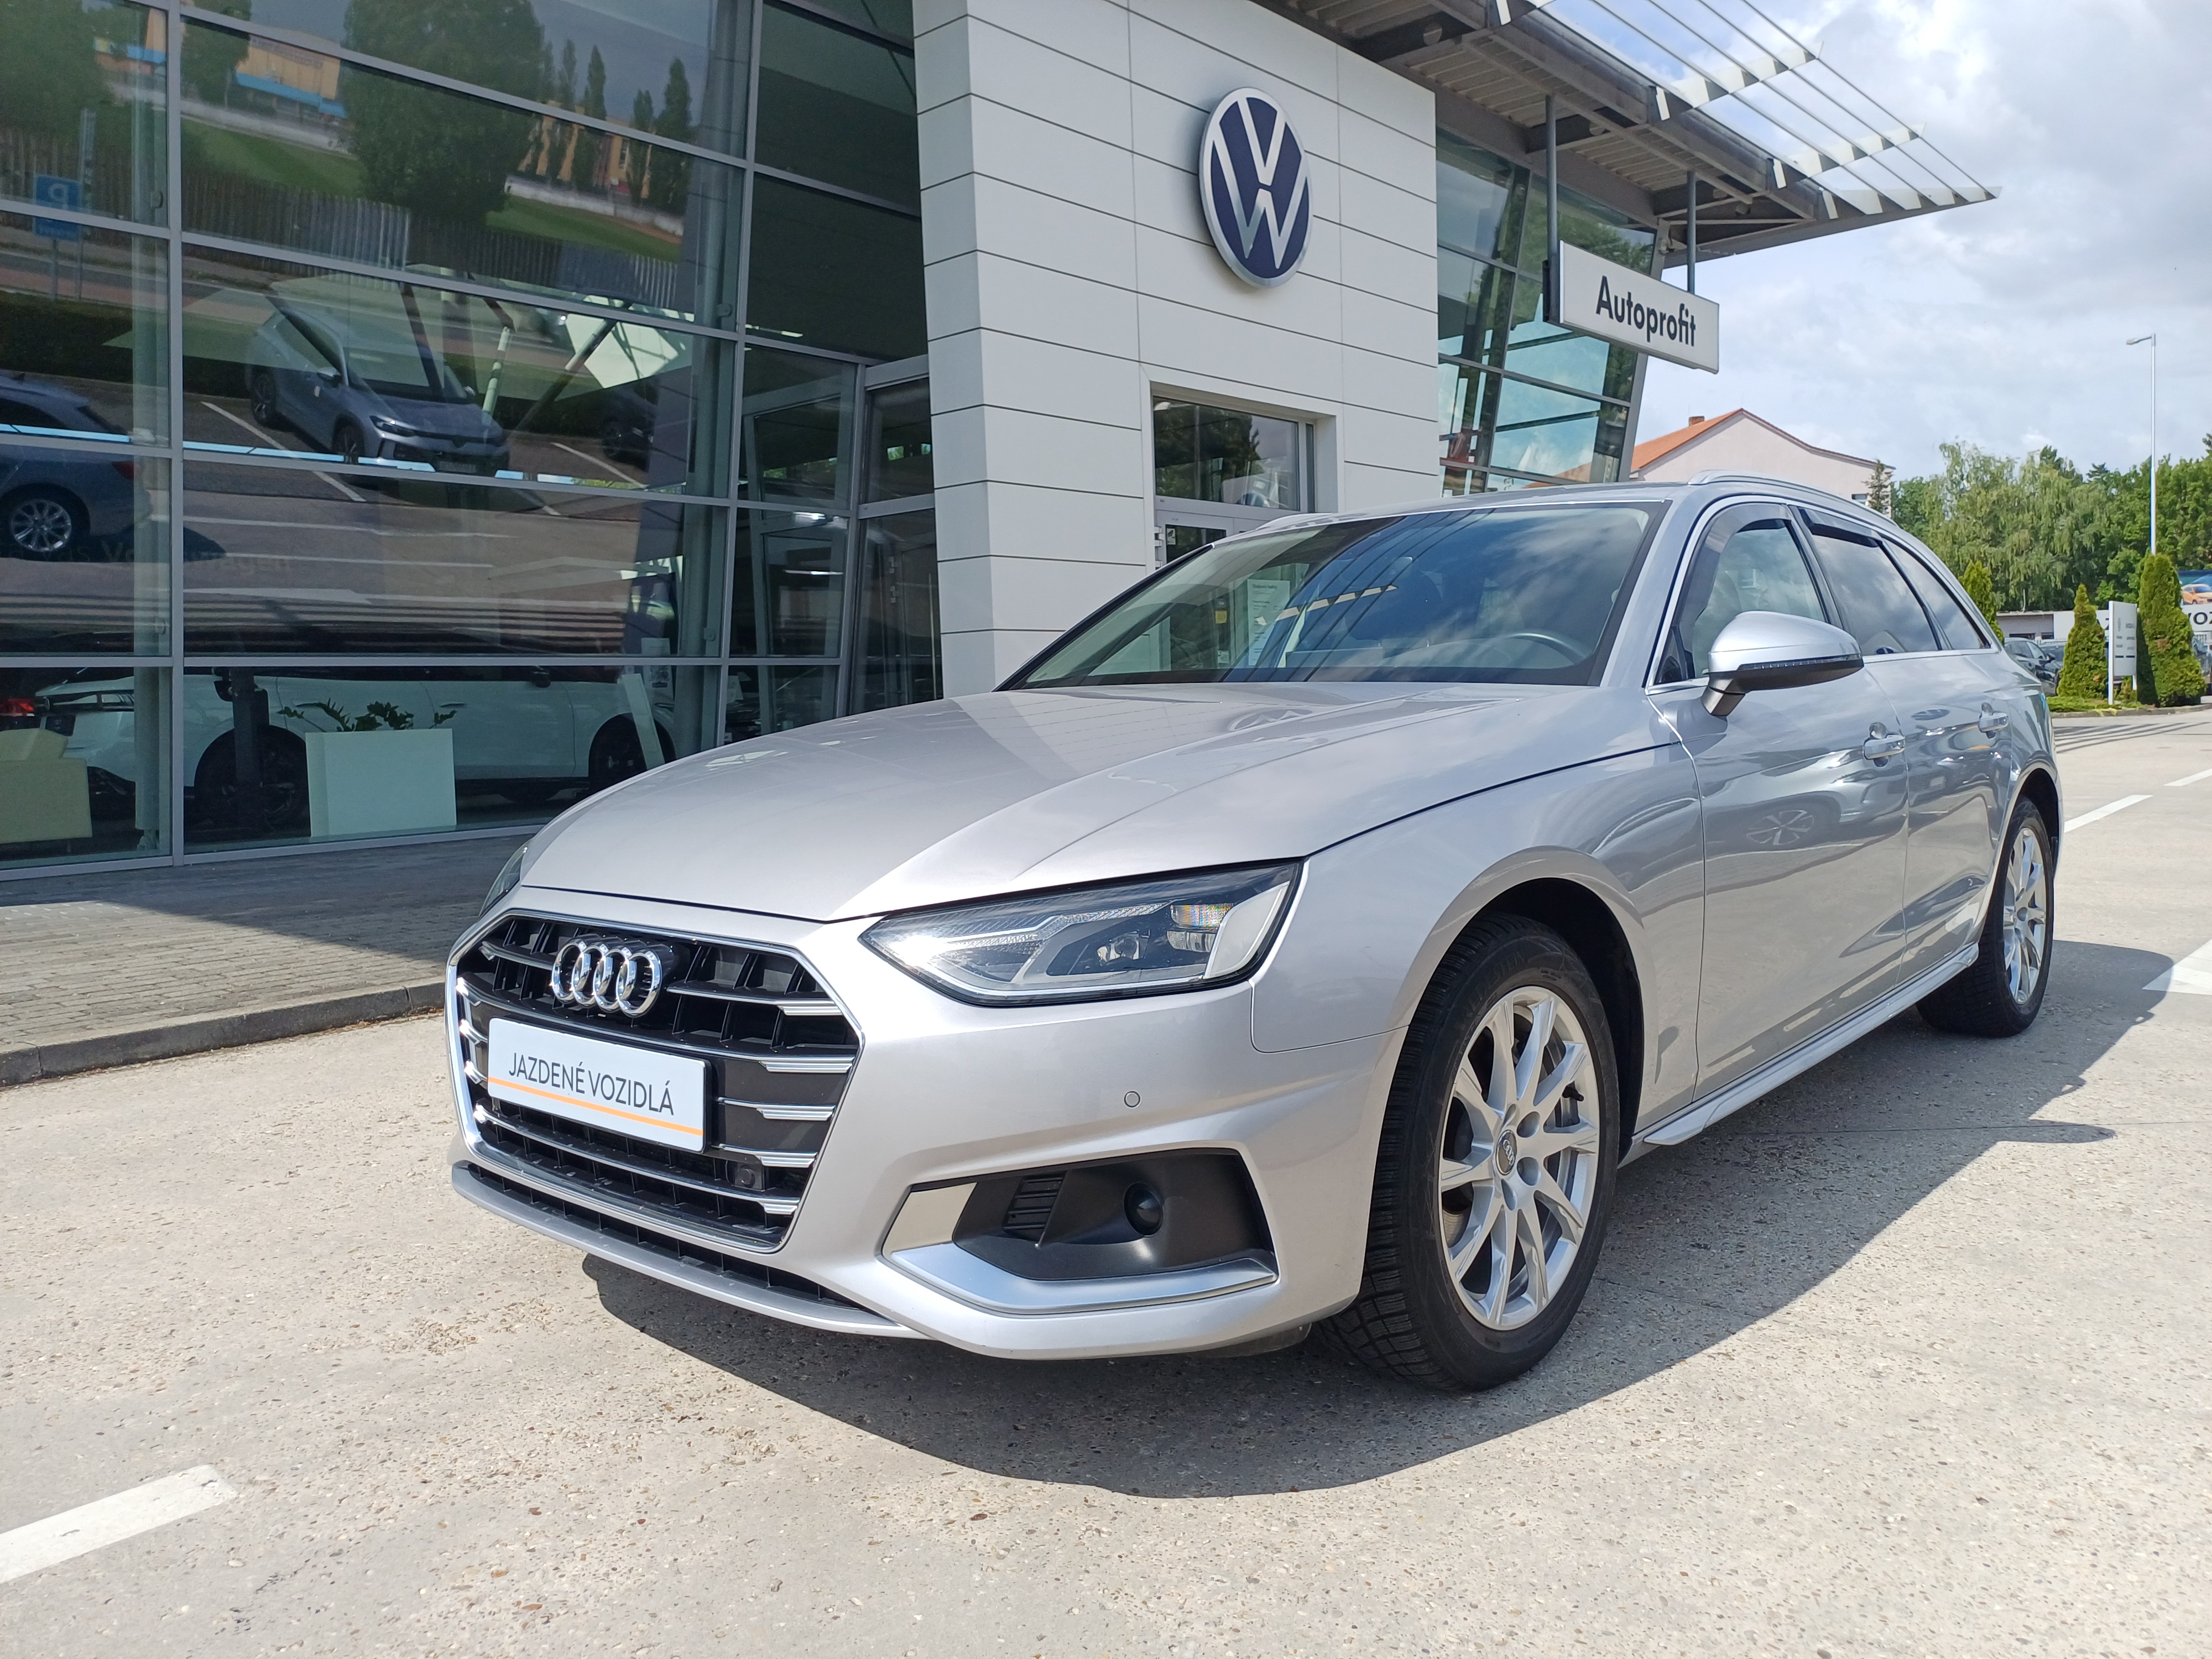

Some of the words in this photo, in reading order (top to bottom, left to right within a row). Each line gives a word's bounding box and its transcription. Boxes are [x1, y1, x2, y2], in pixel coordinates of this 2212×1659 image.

[1596, 275, 1696, 347] Autoprofit
[509, 1052, 585, 1094] JAZDENÉ
[588, 1070, 675, 1116] VOZIDLÁ
